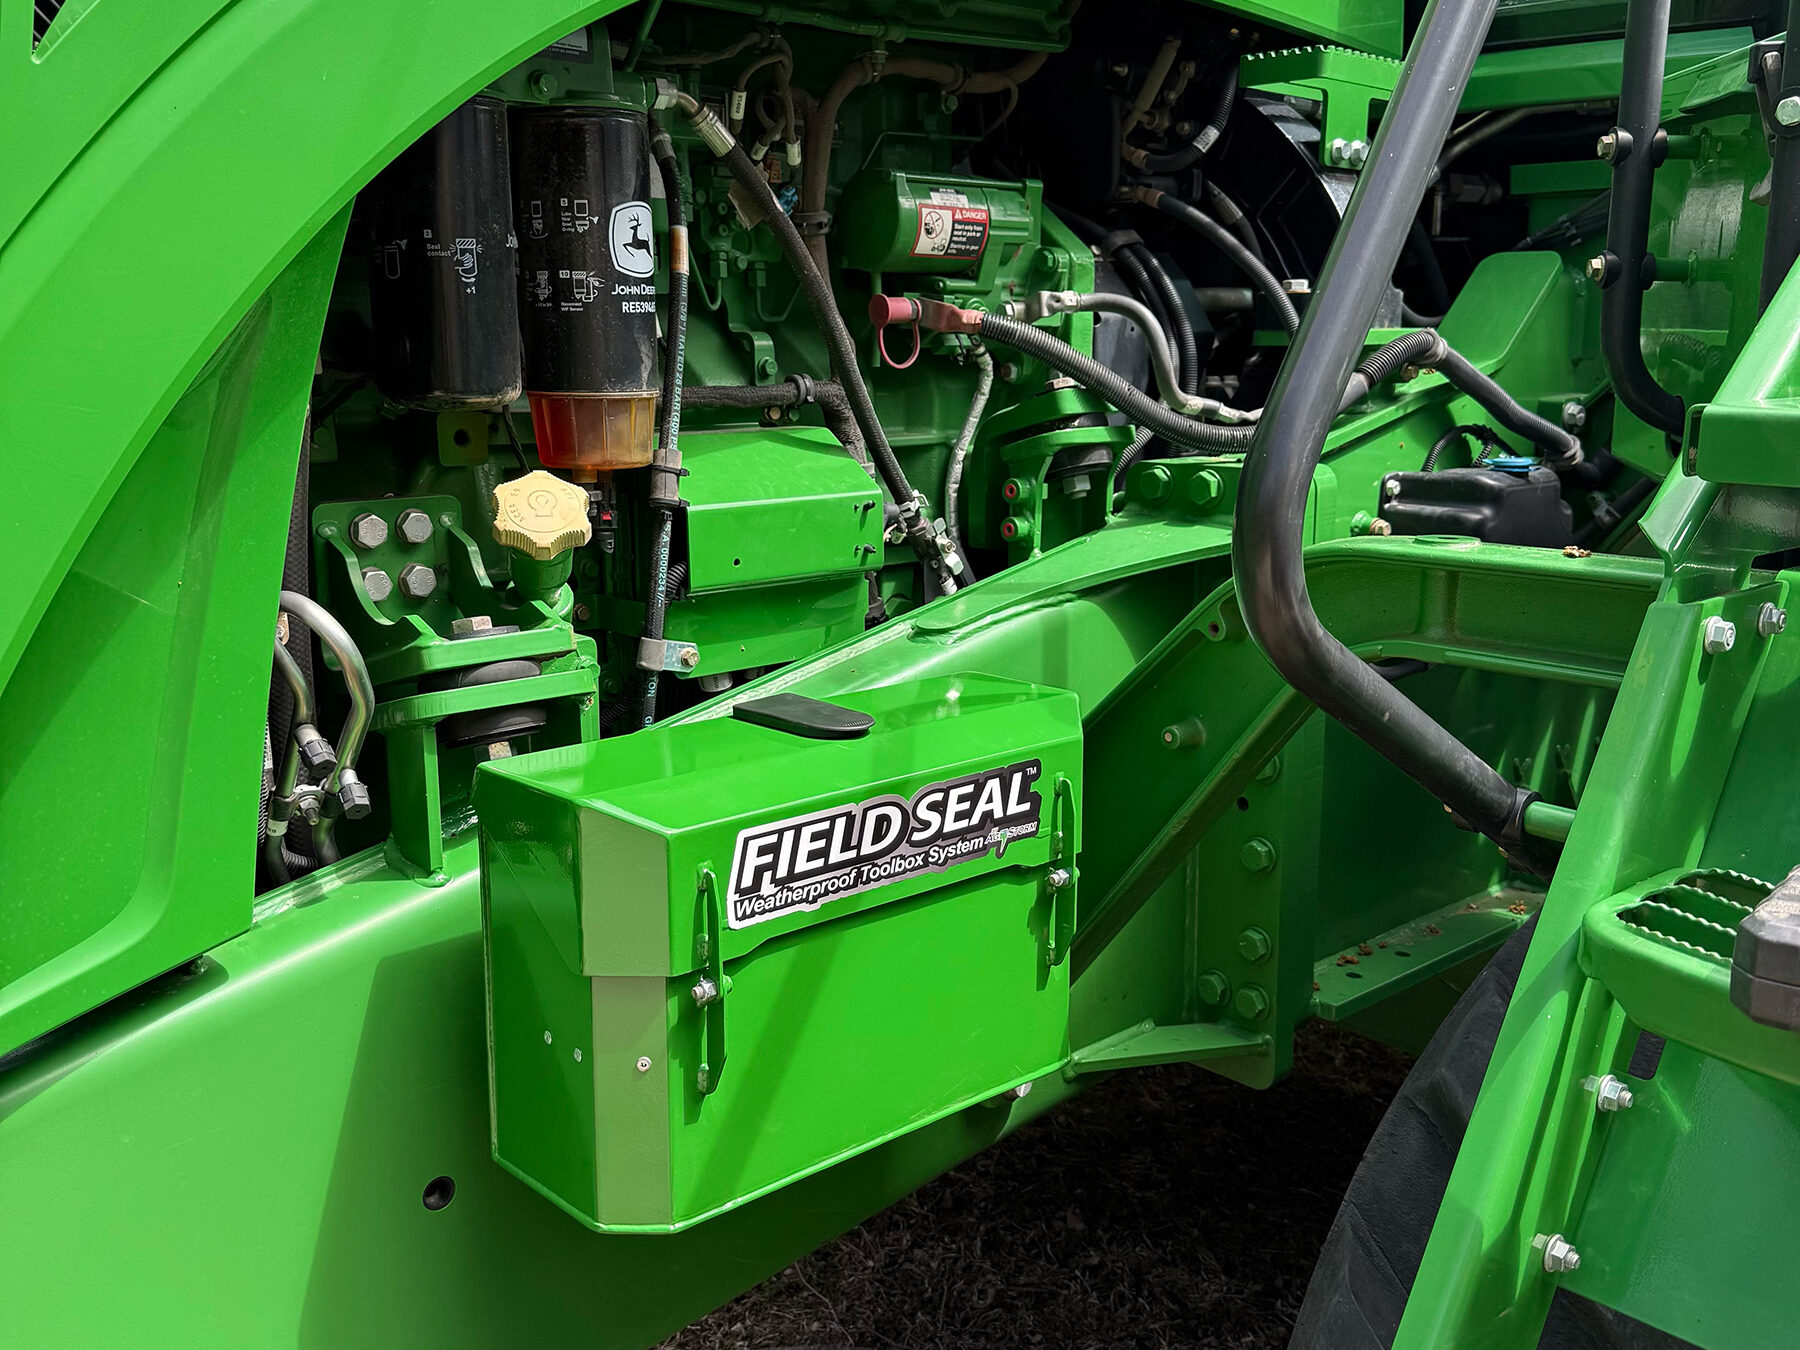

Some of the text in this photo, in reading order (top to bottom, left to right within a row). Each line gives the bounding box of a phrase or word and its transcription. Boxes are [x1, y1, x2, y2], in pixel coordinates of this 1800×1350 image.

[962, 210, 986, 220] DANGER
[559, 270, 570, 278] 10
[466, 286, 476, 294] +1
[612, 283, 640, 295] JOHN
[677, 334, 687, 371] RATED
[675, 372, 683, 385] 28
[673, 386, 682, 410] BAR
[671, 411, 680, 435] (400
[669, 436, 677, 451] PS
[658, 547, 668, 591] 0000234
[740, 805, 903, 890] FIELD
[911, 772, 1031, 841] SEAL
[735, 836, 984, 918] Weatherproof Toolbox System
